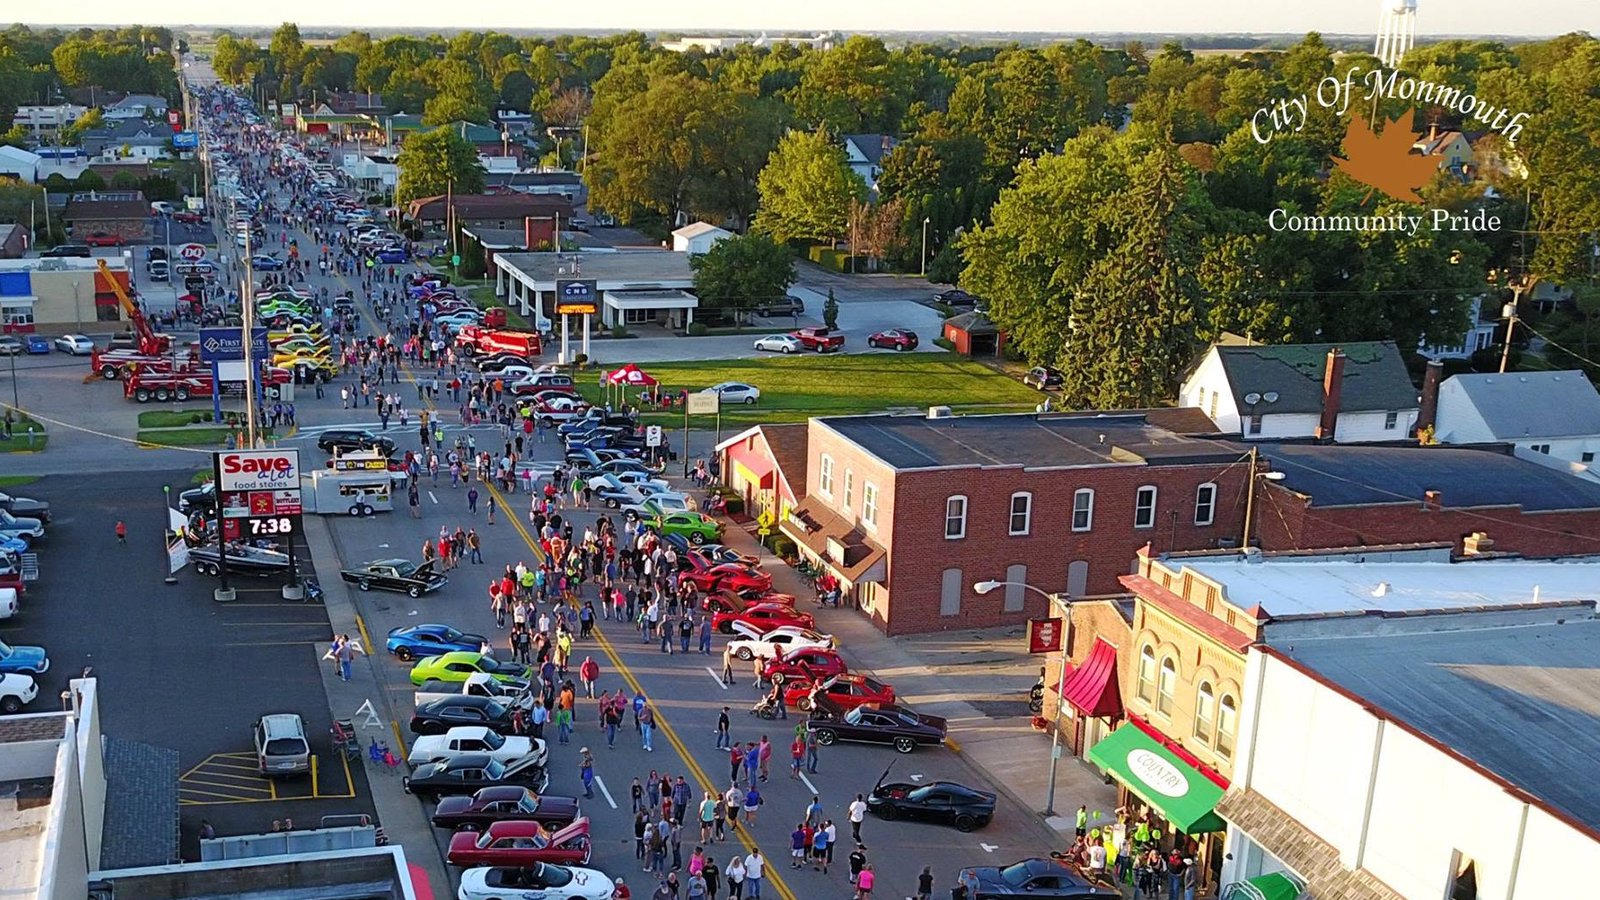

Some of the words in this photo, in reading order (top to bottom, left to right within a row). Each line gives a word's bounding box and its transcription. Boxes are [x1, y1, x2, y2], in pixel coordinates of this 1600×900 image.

[185, 248, 202, 258] DQ
[223, 455, 290, 474] Save
[257, 468, 269, 479] a
[234, 481, 256, 489] food
[259, 480, 288, 488] stores
[249, 518, 292, 534] 7:38
[1136, 753, 1181, 789] COUNTRY
